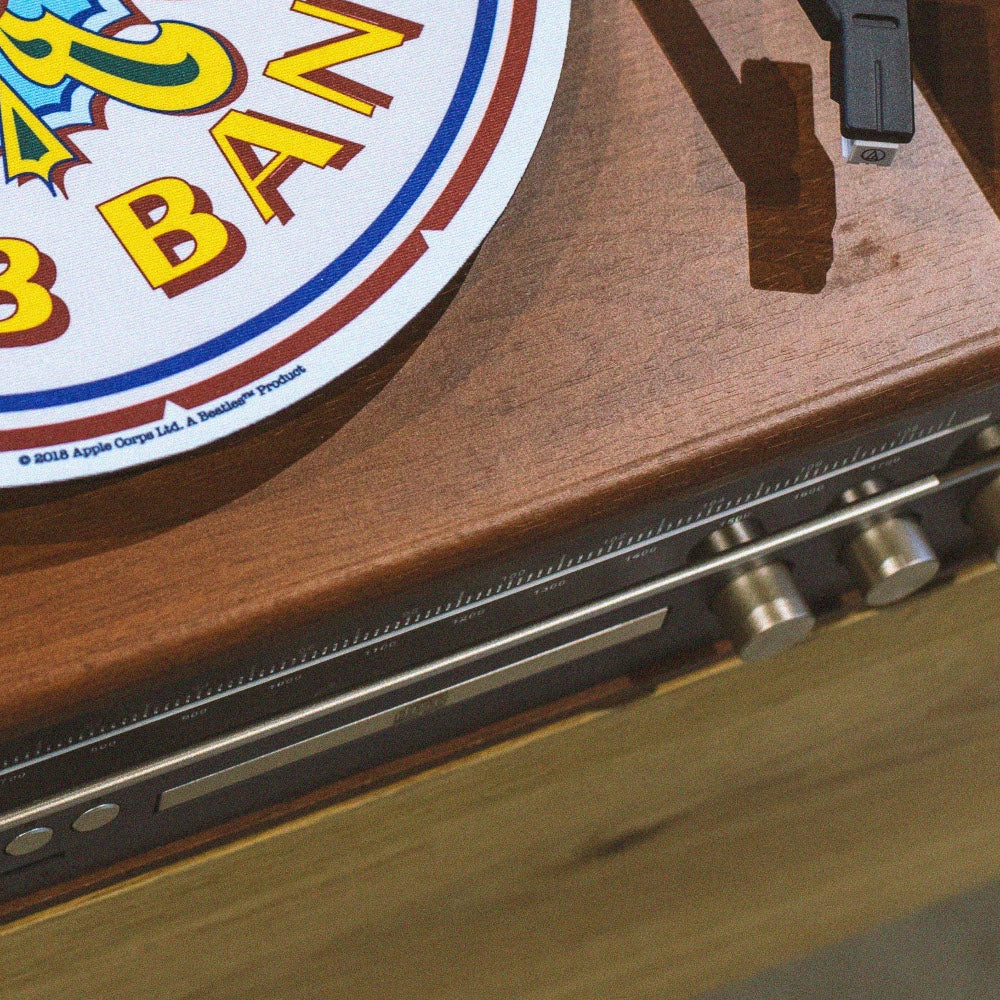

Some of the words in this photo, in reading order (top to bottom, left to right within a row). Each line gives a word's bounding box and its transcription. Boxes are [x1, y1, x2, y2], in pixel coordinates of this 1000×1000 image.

[34, 449, 69, 464] 2018
[73, 441, 112, 459] Apple
[114, 430, 155, 449] Corps
[155, 420, 184, 437] Ltd.
[186, 416, 198, 427] A
[256, 364, 307, 397] Product
